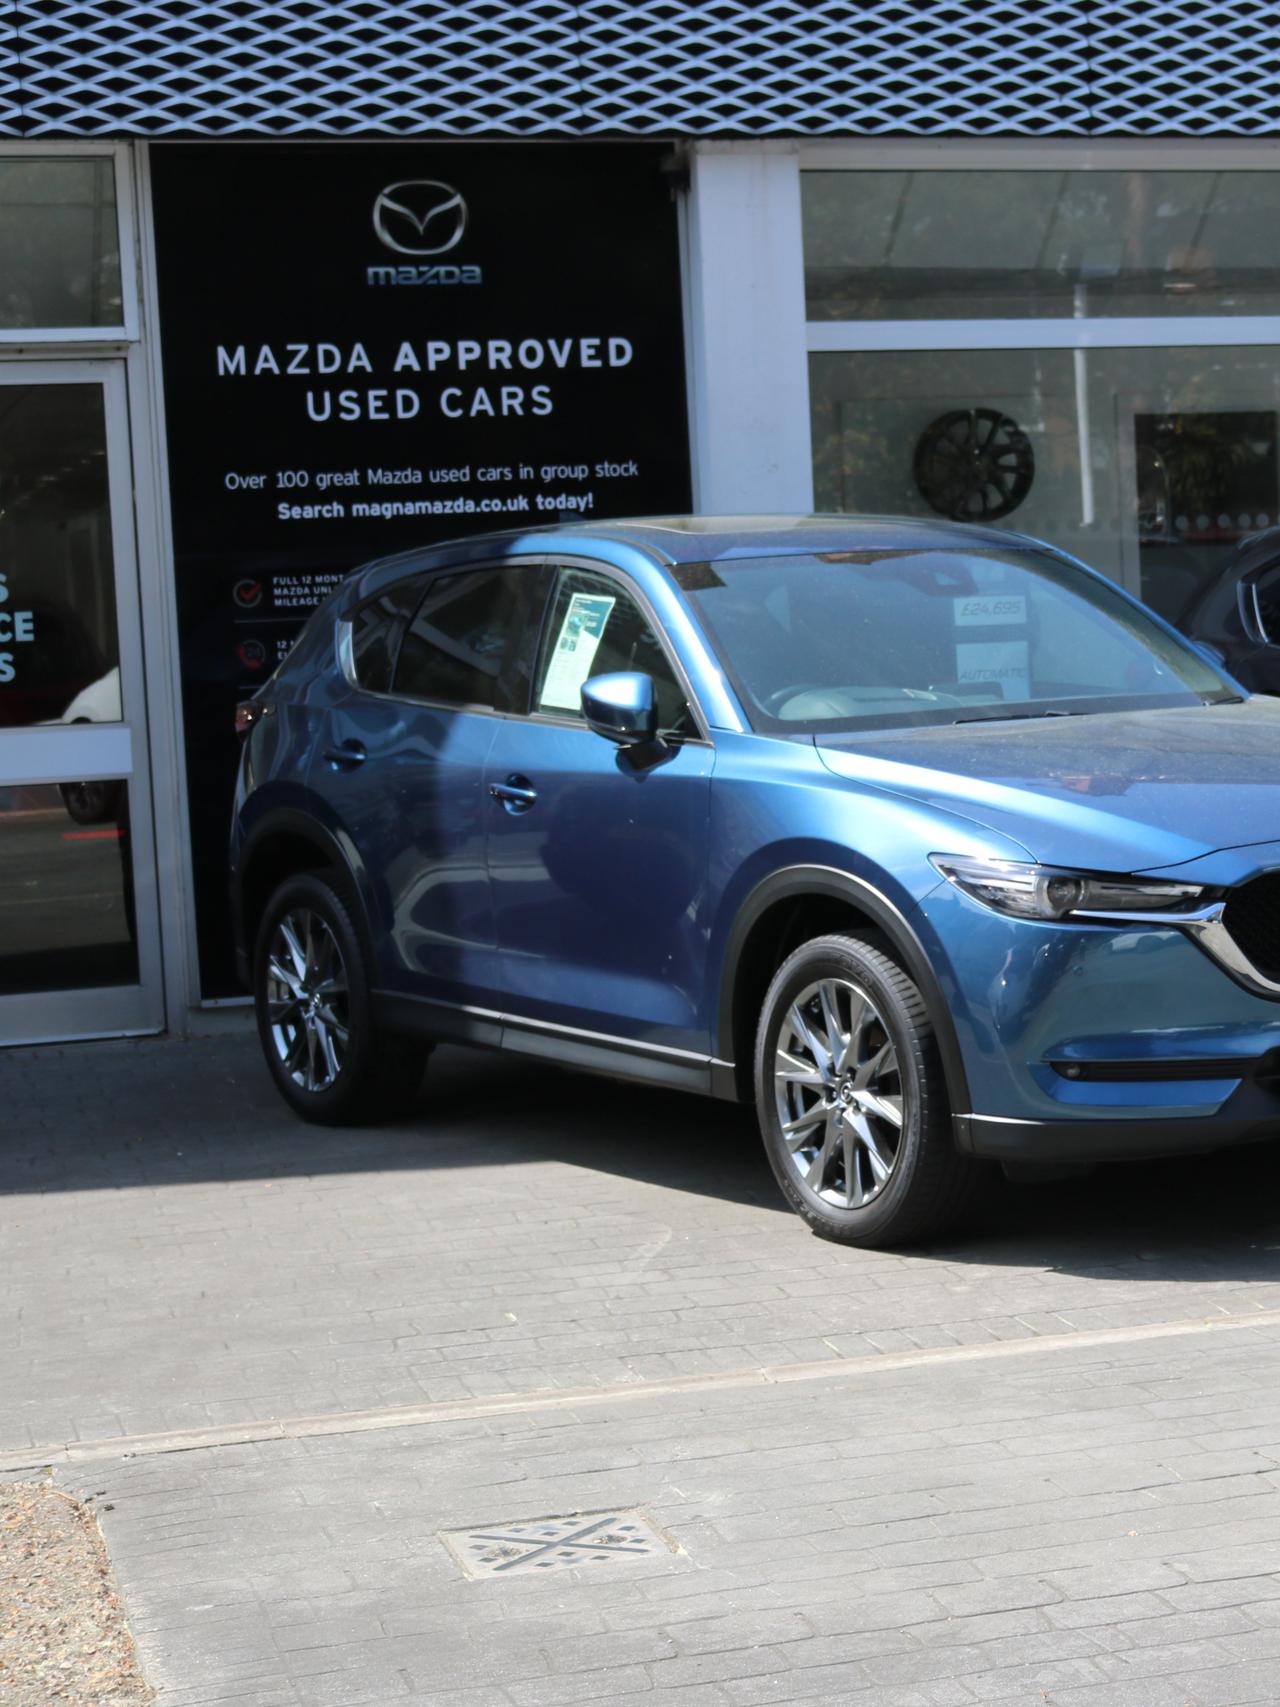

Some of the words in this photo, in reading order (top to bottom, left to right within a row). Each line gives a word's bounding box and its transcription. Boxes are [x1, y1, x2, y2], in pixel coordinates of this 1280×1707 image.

[366, 265, 482, 285] mazda
[216, 342, 373, 376] MAZDA
[393, 337, 634, 372] APPROVED
[306, 389, 421, 422] USED
[440, 384, 553, 418] CARS
[225, 472, 267, 490] Over
[277, 470, 309, 489] 100
[315, 469, 360, 491] great
[368, 467, 422, 485] Mazda
[429, 465, 470, 484] used
[476, 466, 512, 482] cars
[519, 463, 534, 480] in
[540, 464, 589, 483] group
[595, 459, 639, 478] stock
[277, 501, 345, 520] Search
[352, 494, 530, 520] magnamazda.co.uk
[535, 491, 594, 513] today!
[272, 576, 300, 585] FULL
[302, 575, 312, 585] 12
[315, 574, 344, 584] MONT
[273, 586, 311, 596] MAZDA
[274, 596, 319, 606] MILEAGE
